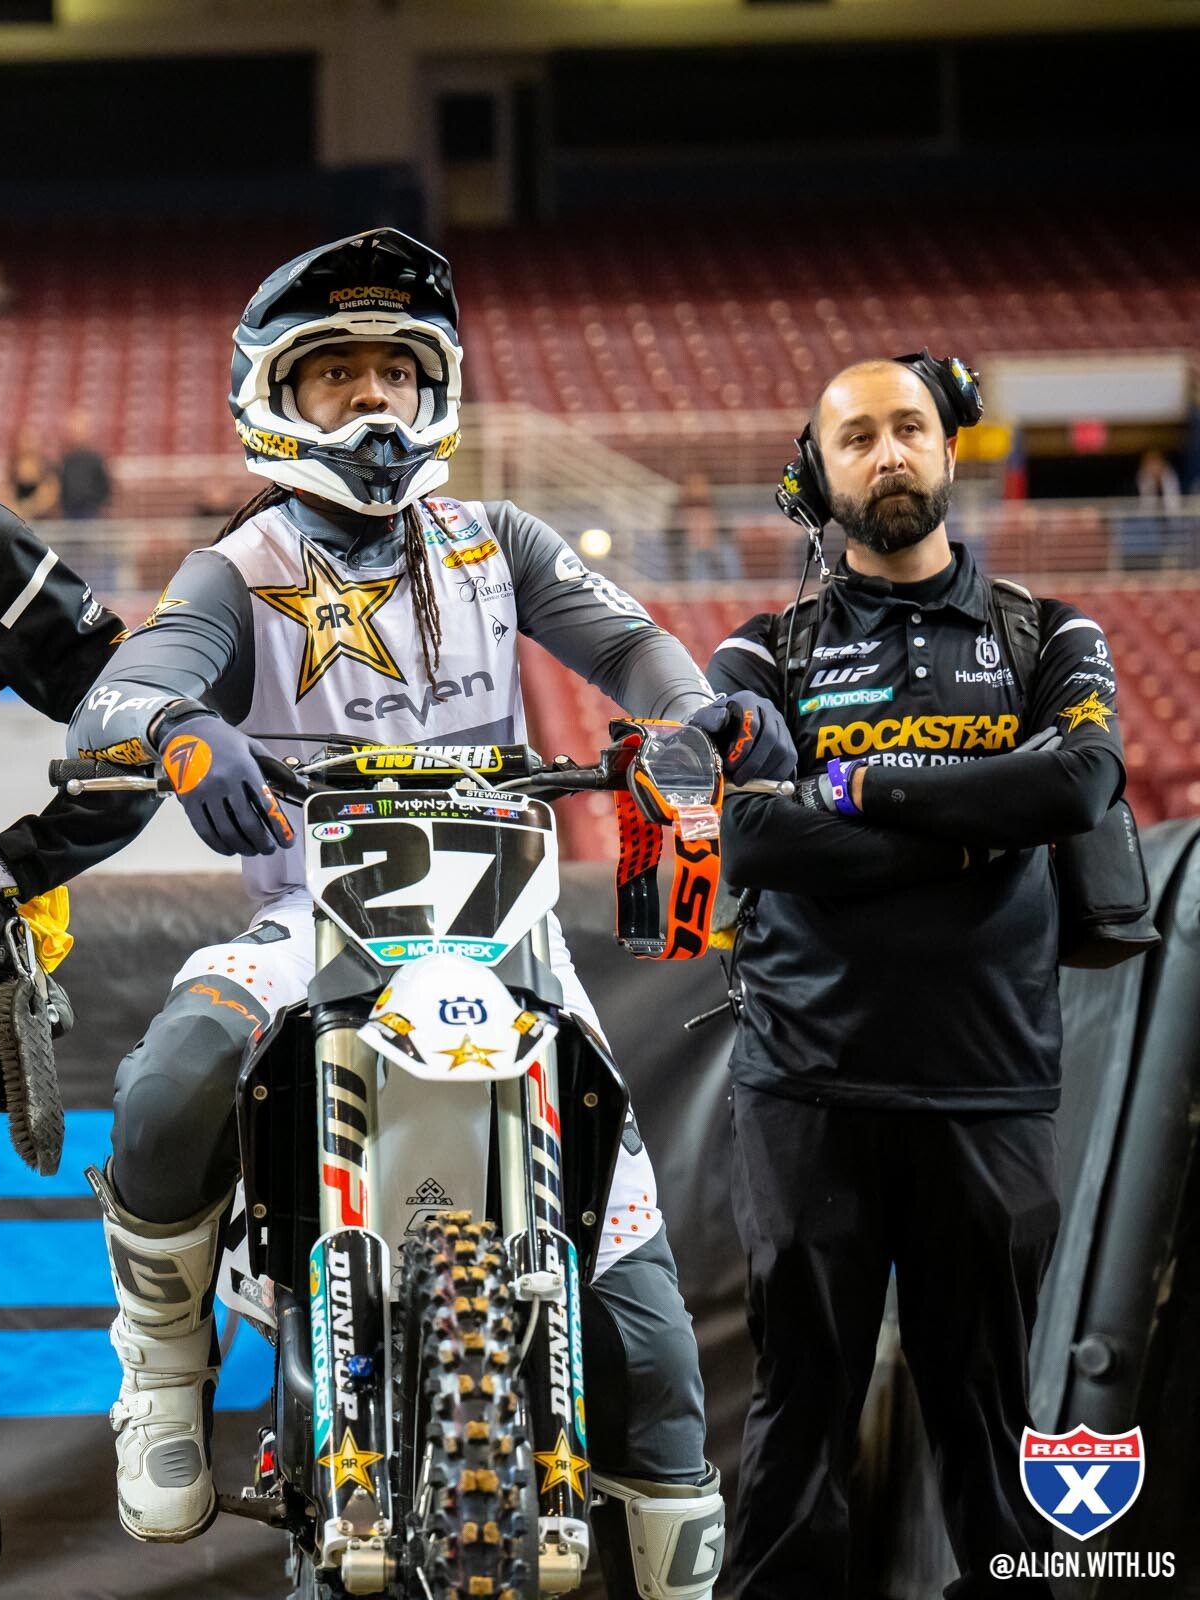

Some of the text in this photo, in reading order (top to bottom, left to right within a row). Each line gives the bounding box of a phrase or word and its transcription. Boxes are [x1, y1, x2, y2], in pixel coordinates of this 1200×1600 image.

[329, 286, 411, 304] ROCKSTAR
[339, 299, 405, 310] ENERGY DRINK
[456, 576, 514, 602] PARADIS
[1081, 655, 1114, 672] SCOTT
[809, 663, 880, 688] WP
[820, 688, 889, 708] MOTOREX
[815, 714, 1020, 759] ROCKSTAR
[866, 752, 927, 769] ERGY
[466, 790, 514, 801] STEWART
[321, 820, 546, 937] 27
[407, 941, 494, 959] MOTOREX
[329, 1248, 359, 1421] DUNLOP
[546, 1244, 573, 1424] DUNLP
[311, 1295, 330, 1430] MOTOREX
